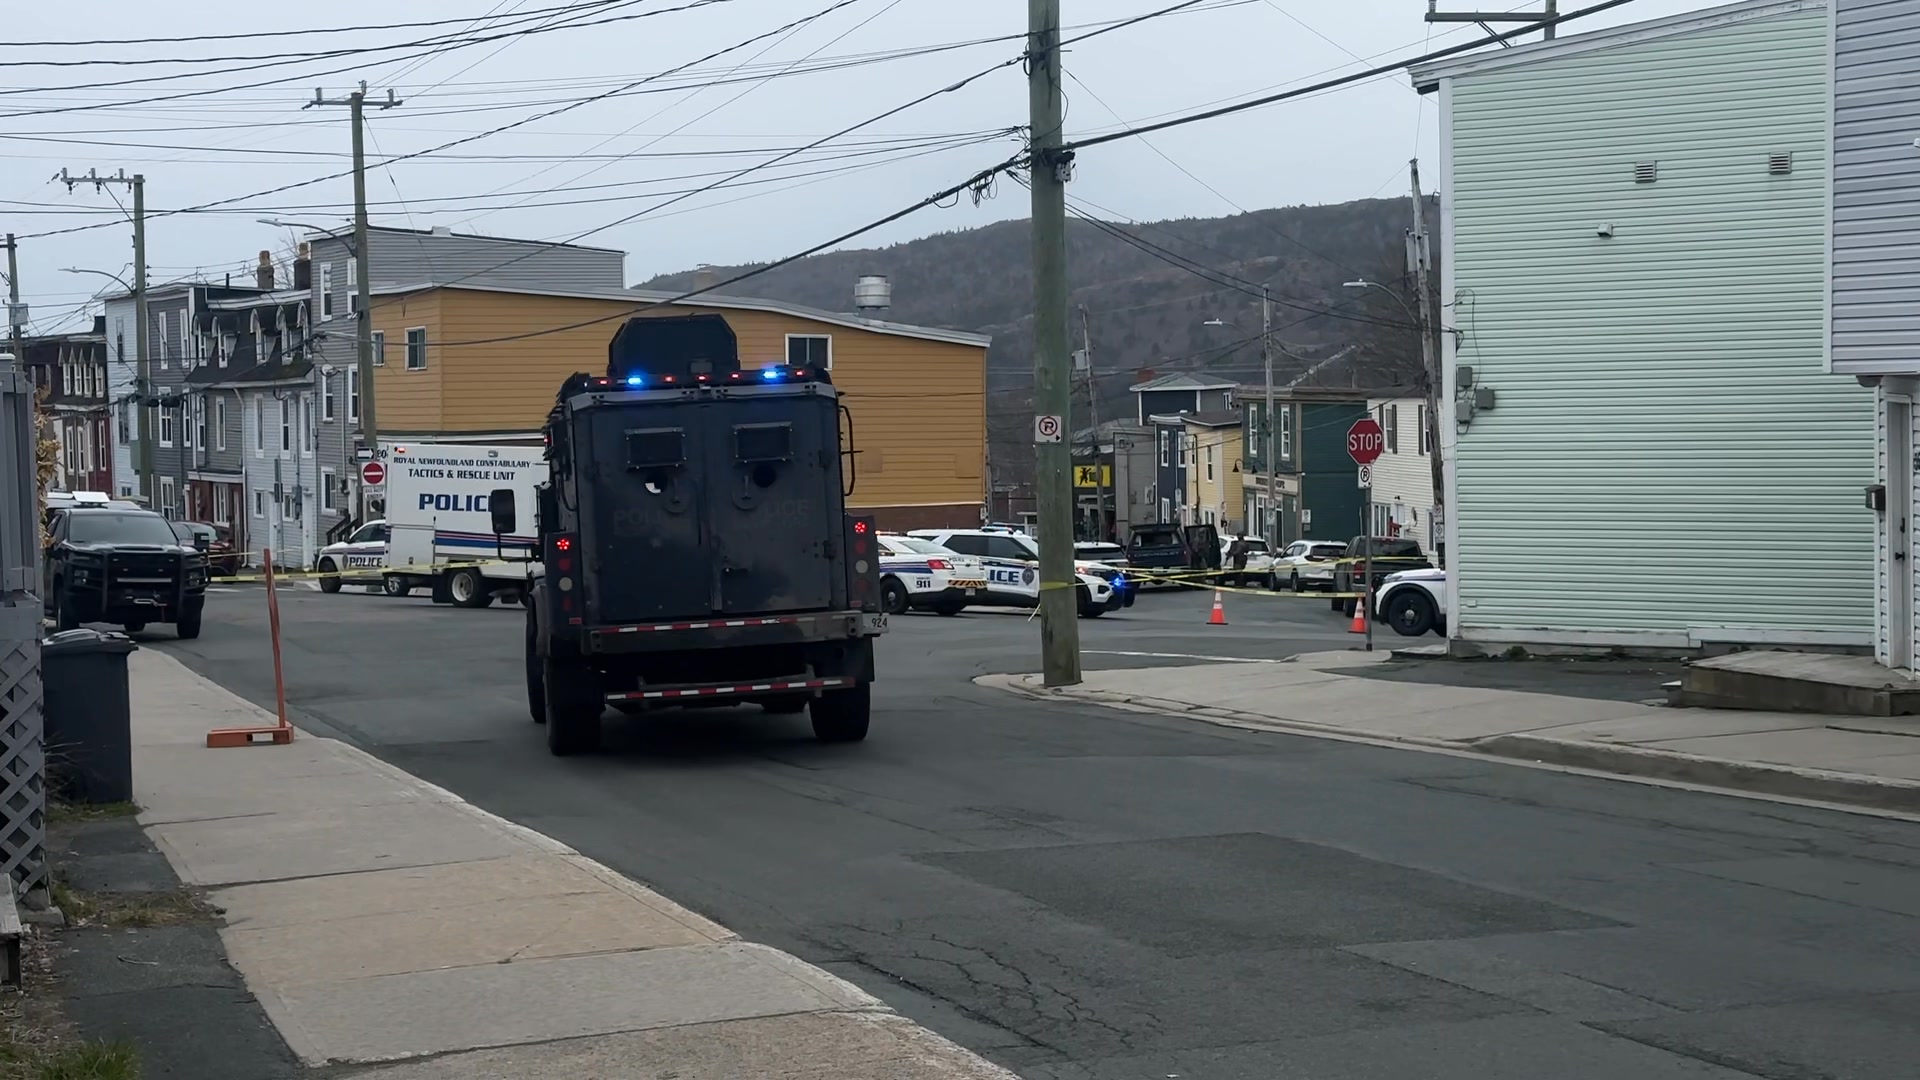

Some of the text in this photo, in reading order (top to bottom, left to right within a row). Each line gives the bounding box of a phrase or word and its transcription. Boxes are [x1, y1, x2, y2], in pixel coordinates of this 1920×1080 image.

[1349, 433, 1382, 451] STOP
[393, 456, 531, 468] ROYAL NEWFOUNDLAND CONSTABULARY
[408, 468, 515, 480] TACTICS & RESCUE UNIT
[419, 493, 491, 512] POLIC
[349, 557, 382, 568] POLICE
[987, 569, 1019, 583] ICE
[916, 580, 931, 589] 911
[871, 617, 888, 628] 924
